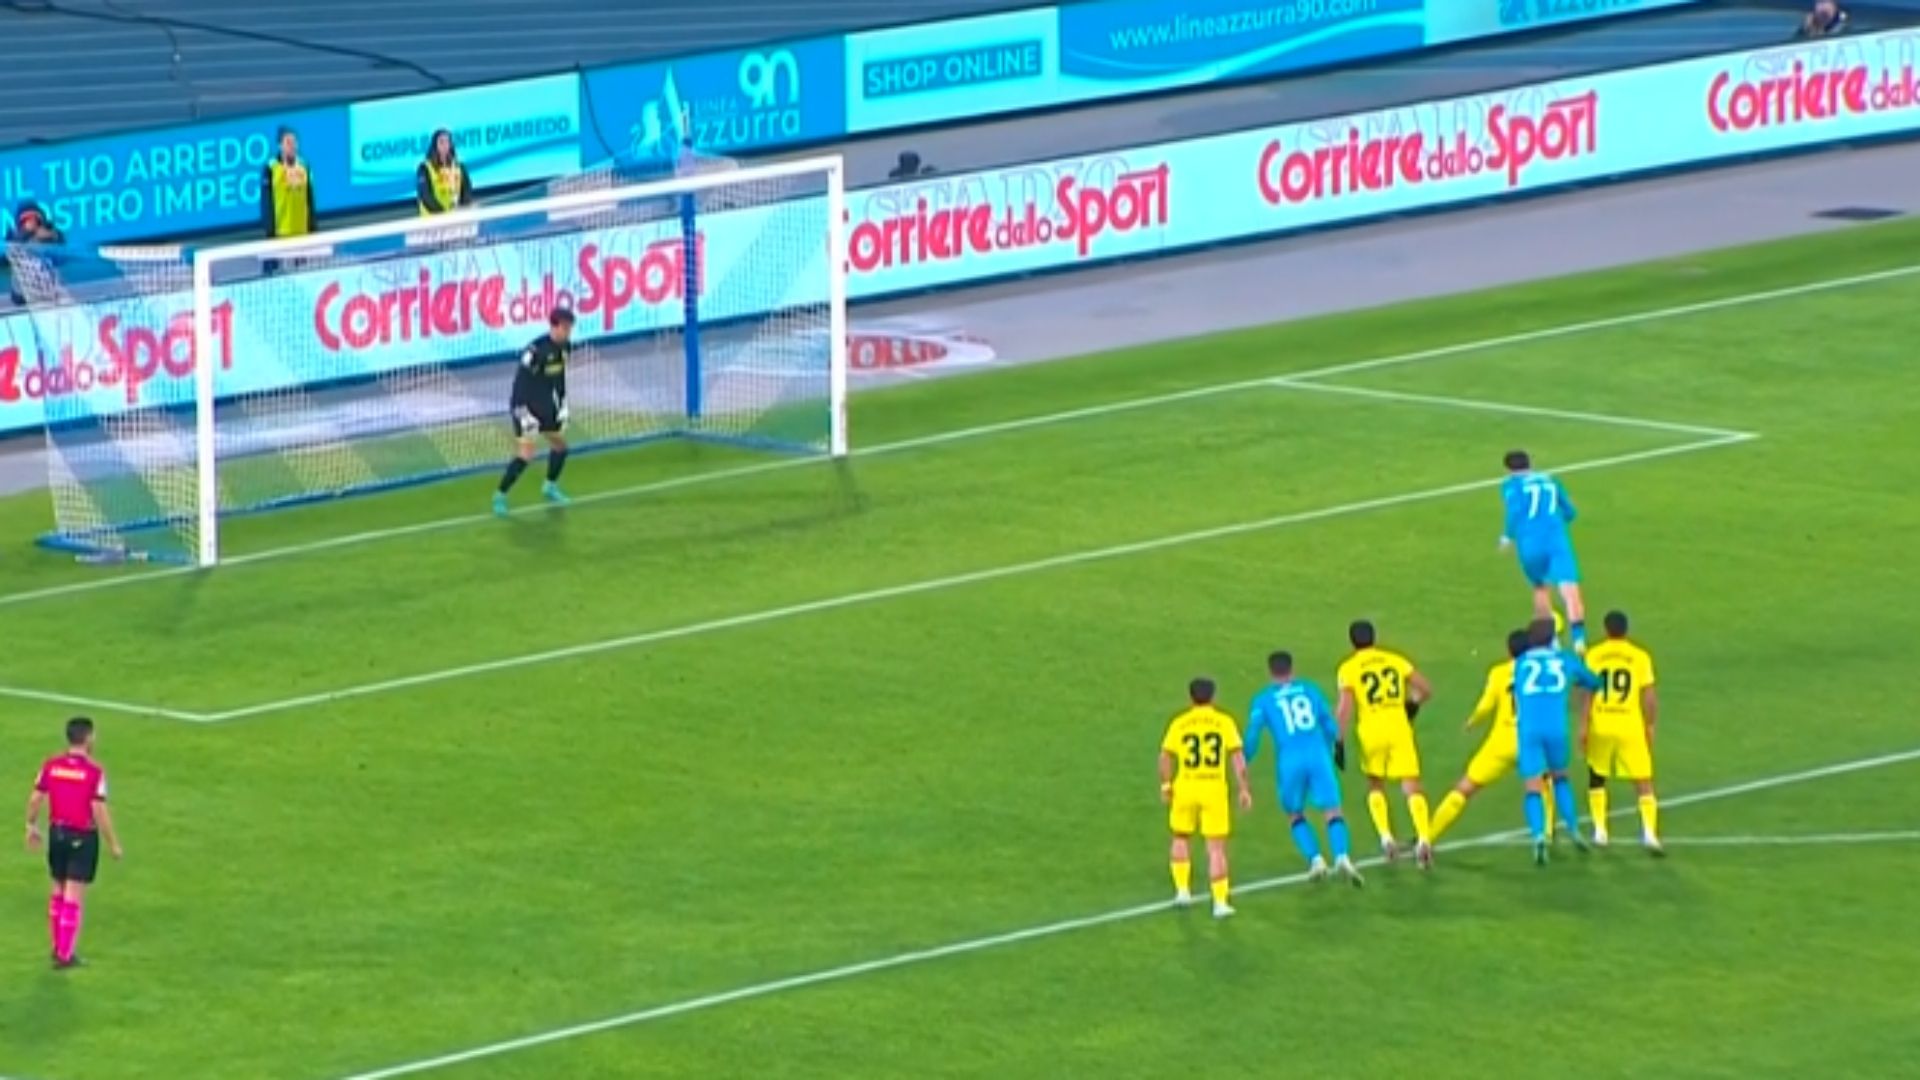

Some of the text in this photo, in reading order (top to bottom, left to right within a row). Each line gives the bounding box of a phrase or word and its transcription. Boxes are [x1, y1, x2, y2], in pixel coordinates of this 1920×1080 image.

[867, 45, 1038, 94] SHOP ONLINE
[1708, 60, 1868, 131] Corriere
[361, 115, 570, 162] COMPLENTI D'ARREDO
[1258, 126, 1423, 205] Corriere
[1486, 89, 1598, 186] Sport
[4, 166, 34, 199] IL
[42, 154, 114, 195] TUO
[125, 133, 269, 184] ARREDO
[1055, 162, 1168, 256] Sport
[314, 266, 505, 351] Corriere
[98, 298, 233, 405] Spot
[1523, 483, 1556, 519] 77
[1361, 667, 1399, 705] 23
[1519, 659, 1566, 696] 23
[1599, 668, 1632, 704] 19
[1276, 694, 1316, 736] 18
[1182, 732, 1223, 769] 33
